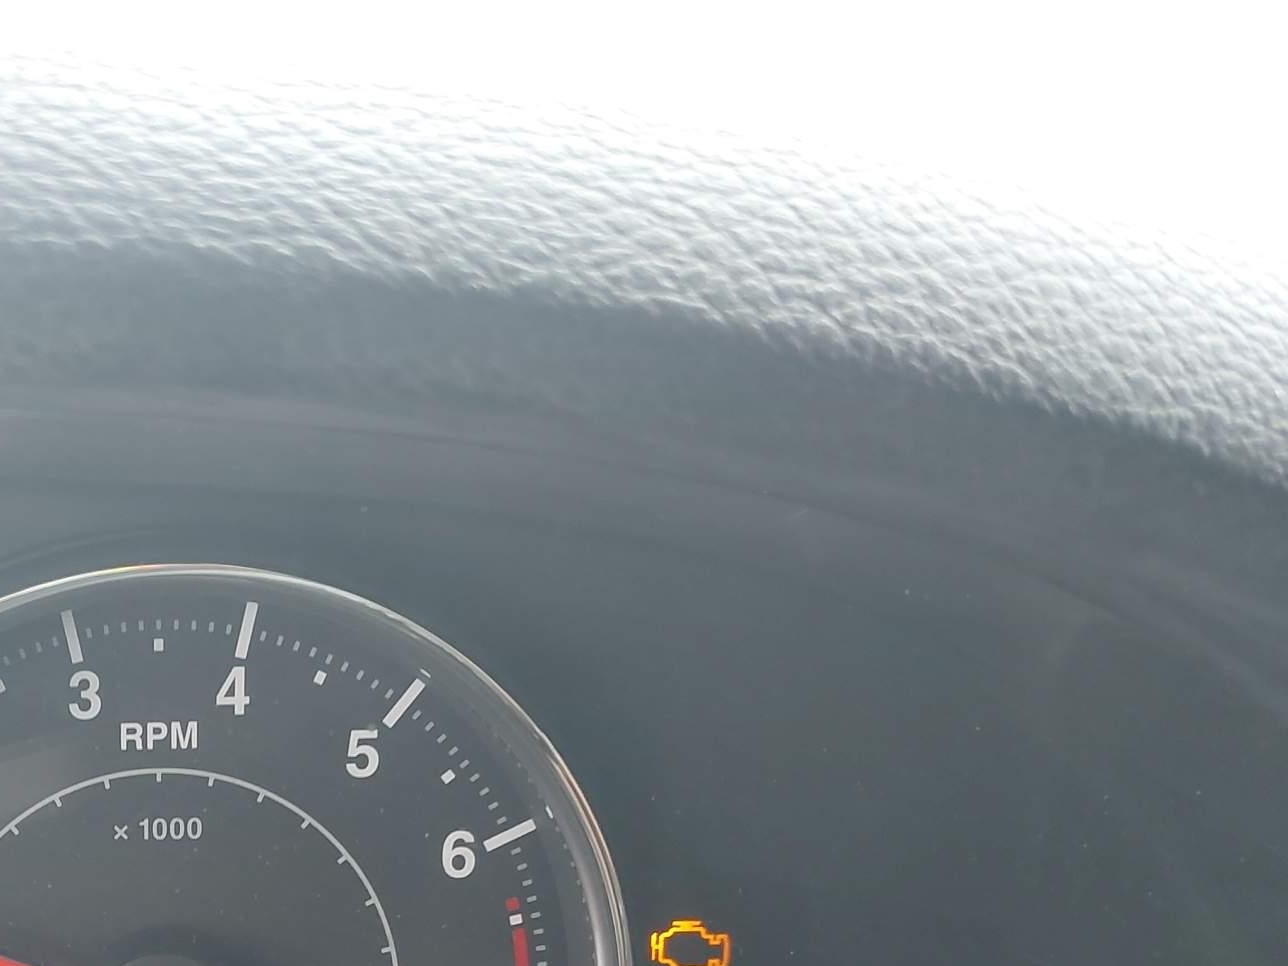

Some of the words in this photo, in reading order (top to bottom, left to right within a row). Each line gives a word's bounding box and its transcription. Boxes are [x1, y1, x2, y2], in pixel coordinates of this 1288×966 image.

[69, 671, 102, 720] 3
[216, 668, 250, 716] 4
[120, 722, 200, 750] RPM
[346, 730, 381, 778] 5
[137, 817, 203, 841] 1000
[442, 829, 475, 877] 6
